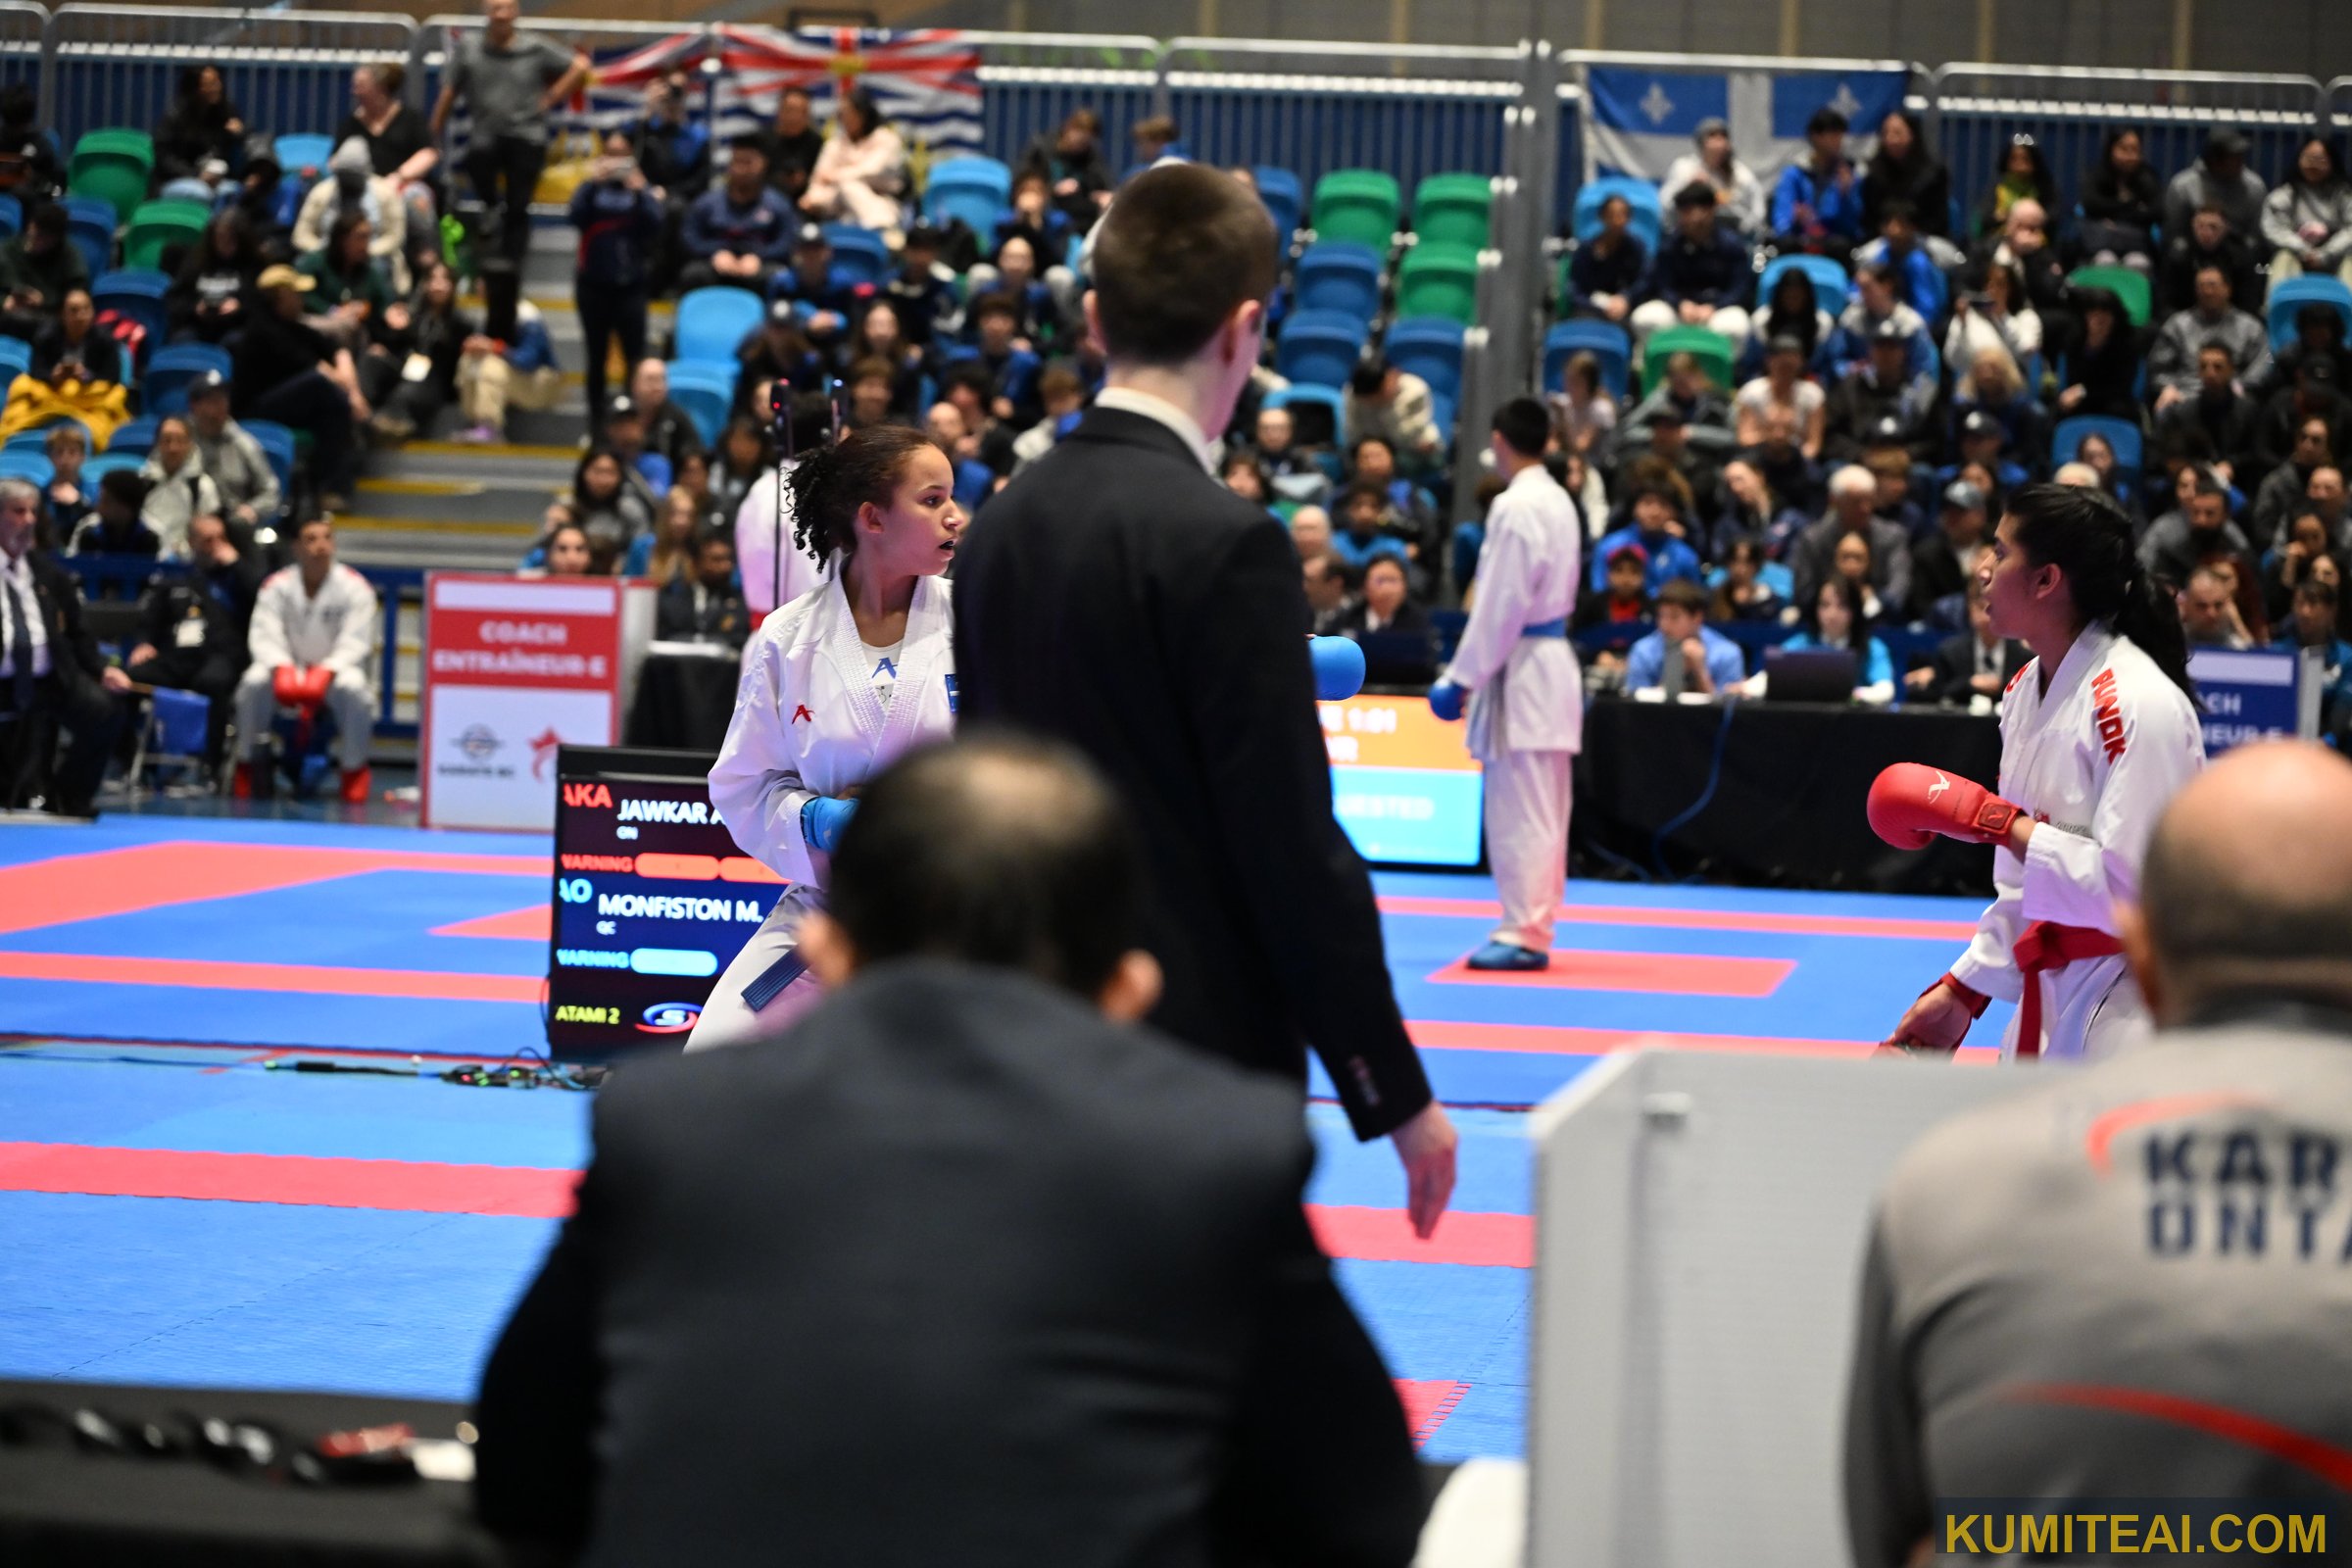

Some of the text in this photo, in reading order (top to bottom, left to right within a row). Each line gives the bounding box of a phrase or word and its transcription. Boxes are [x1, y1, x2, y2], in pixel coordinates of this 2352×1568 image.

[479, 619, 567, 647] COACH
[616, 799, 709, 825] JAWKAR
[598, 893, 764, 923] MONFISTON M.
[608, 1007, 621, 1025] 2
